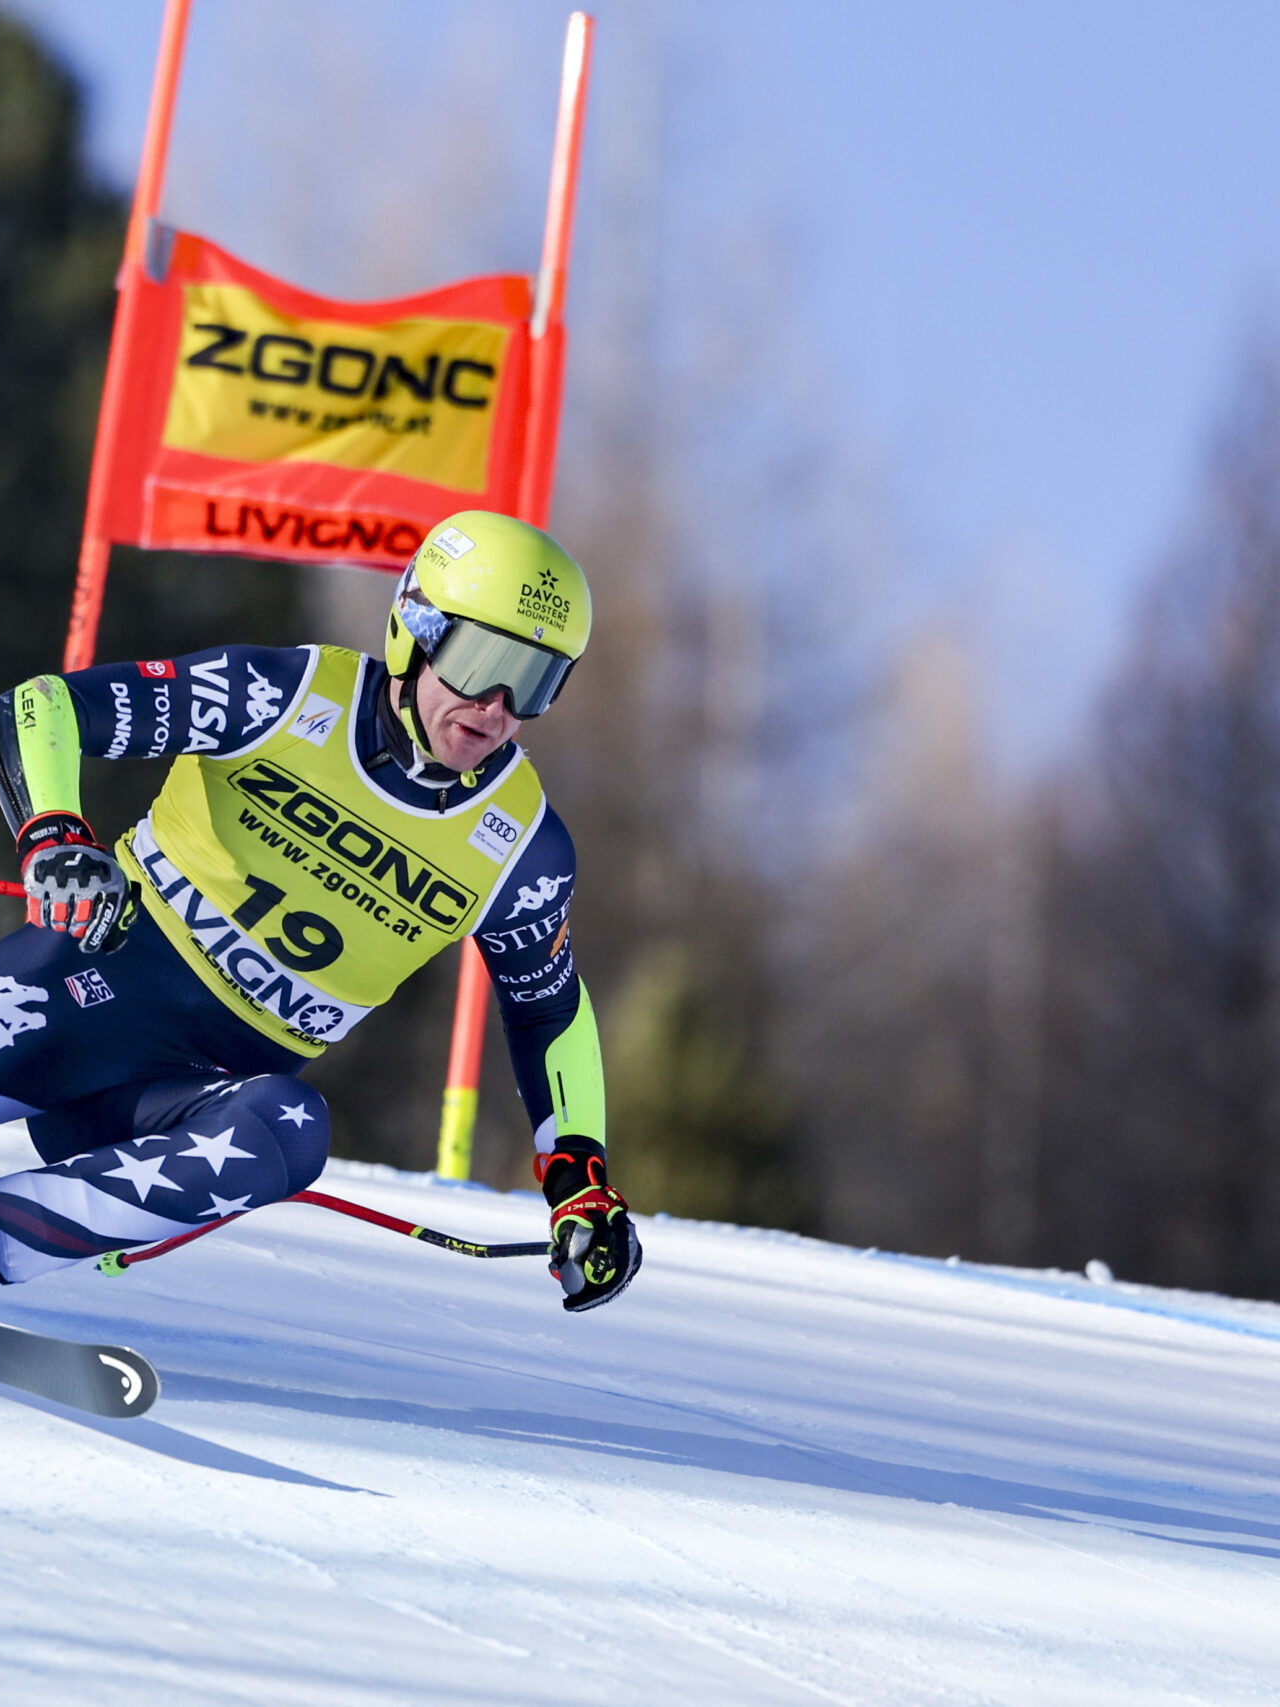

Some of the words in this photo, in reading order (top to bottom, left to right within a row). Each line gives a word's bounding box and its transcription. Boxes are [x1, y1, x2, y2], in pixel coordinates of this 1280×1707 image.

[186, 323, 495, 407] ZGONC
[206, 502, 424, 556] LIVIGNO
[423, 548, 450, 570] SMITH
[517, 608, 565, 632] MOUNTAINS
[519, 597, 568, 623] KLOSTERS
[521, 583, 571, 613] DAVOS
[22, 687, 36, 729] LEKI
[142, 684, 171, 759] TOYOTA
[181, 652, 230, 754] VISA
[237, 763, 468, 926] ZGONC
[238, 808, 424, 943] www.zgonc.at
[89, 902, 114, 946] reusch
[231, 874, 344, 972] 19
[481, 896, 573, 954] STIFE
[86, 970, 112, 1000] US
[568, 1201, 609, 1212] LEKI
